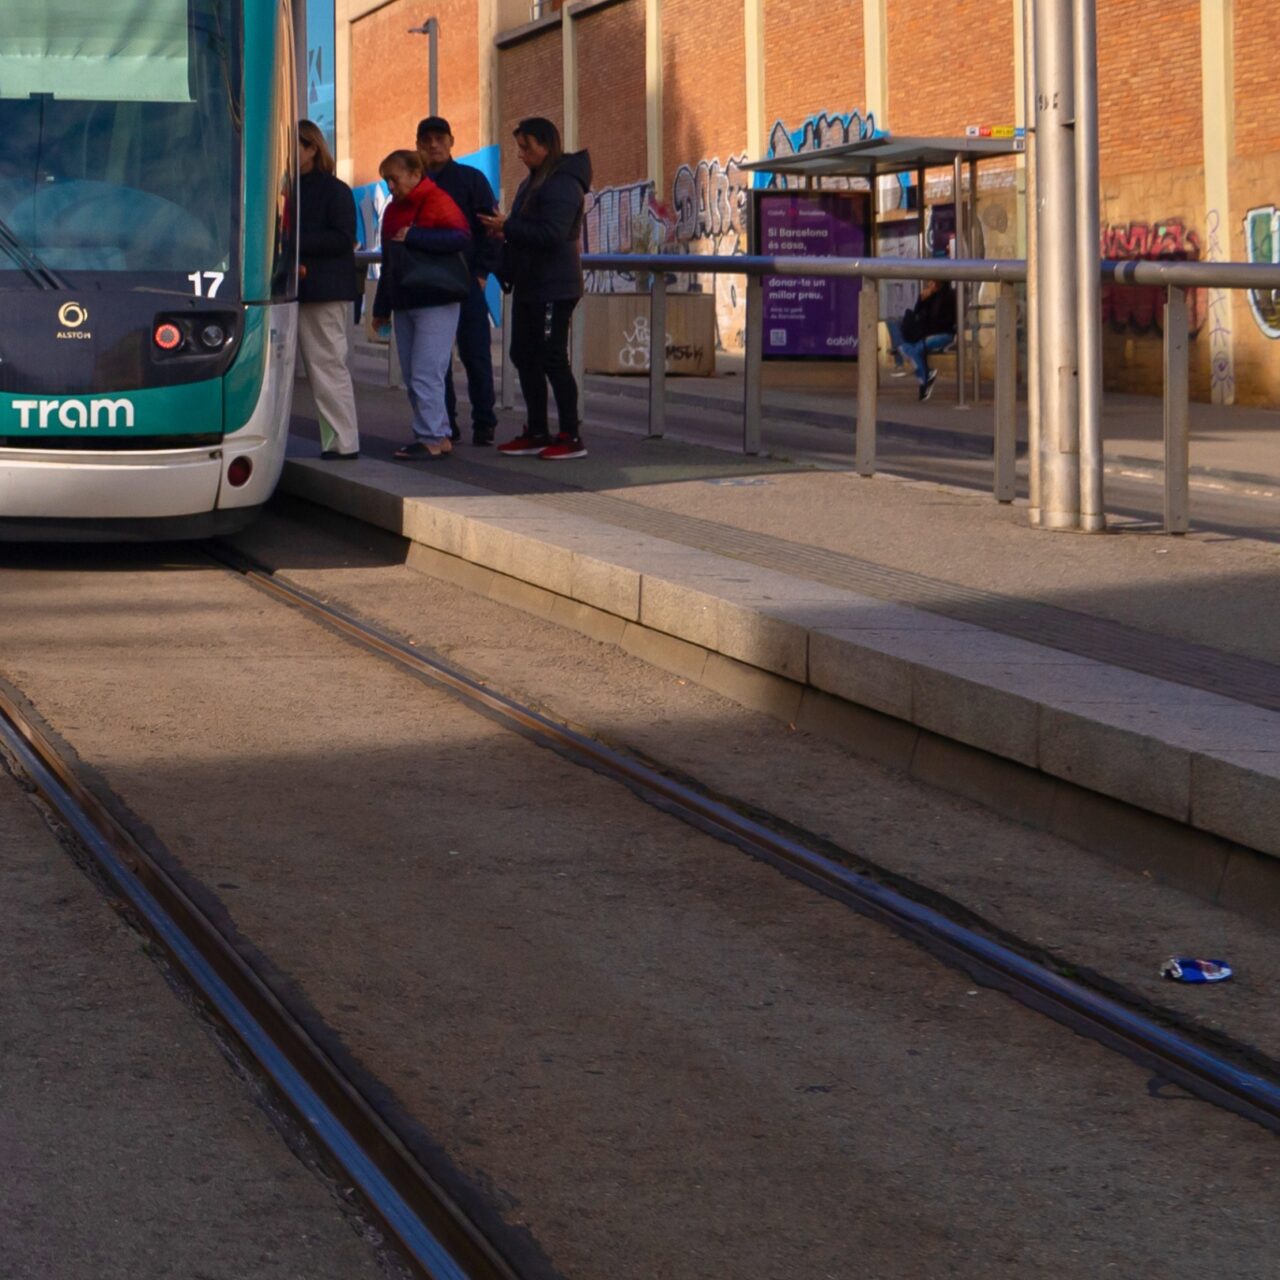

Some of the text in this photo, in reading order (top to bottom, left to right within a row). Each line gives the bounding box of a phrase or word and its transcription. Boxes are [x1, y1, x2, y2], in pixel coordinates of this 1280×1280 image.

[779, 227, 829, 238] Barcelona
[781, 242, 808, 251] casa,
[188, 271, 224, 298] 17
[768, 277, 826, 288] donar-te un
[768, 290, 823, 302] millor preu.
[56, 331, 92, 340] ALSTOM
[826, 335, 859, 348] cabify
